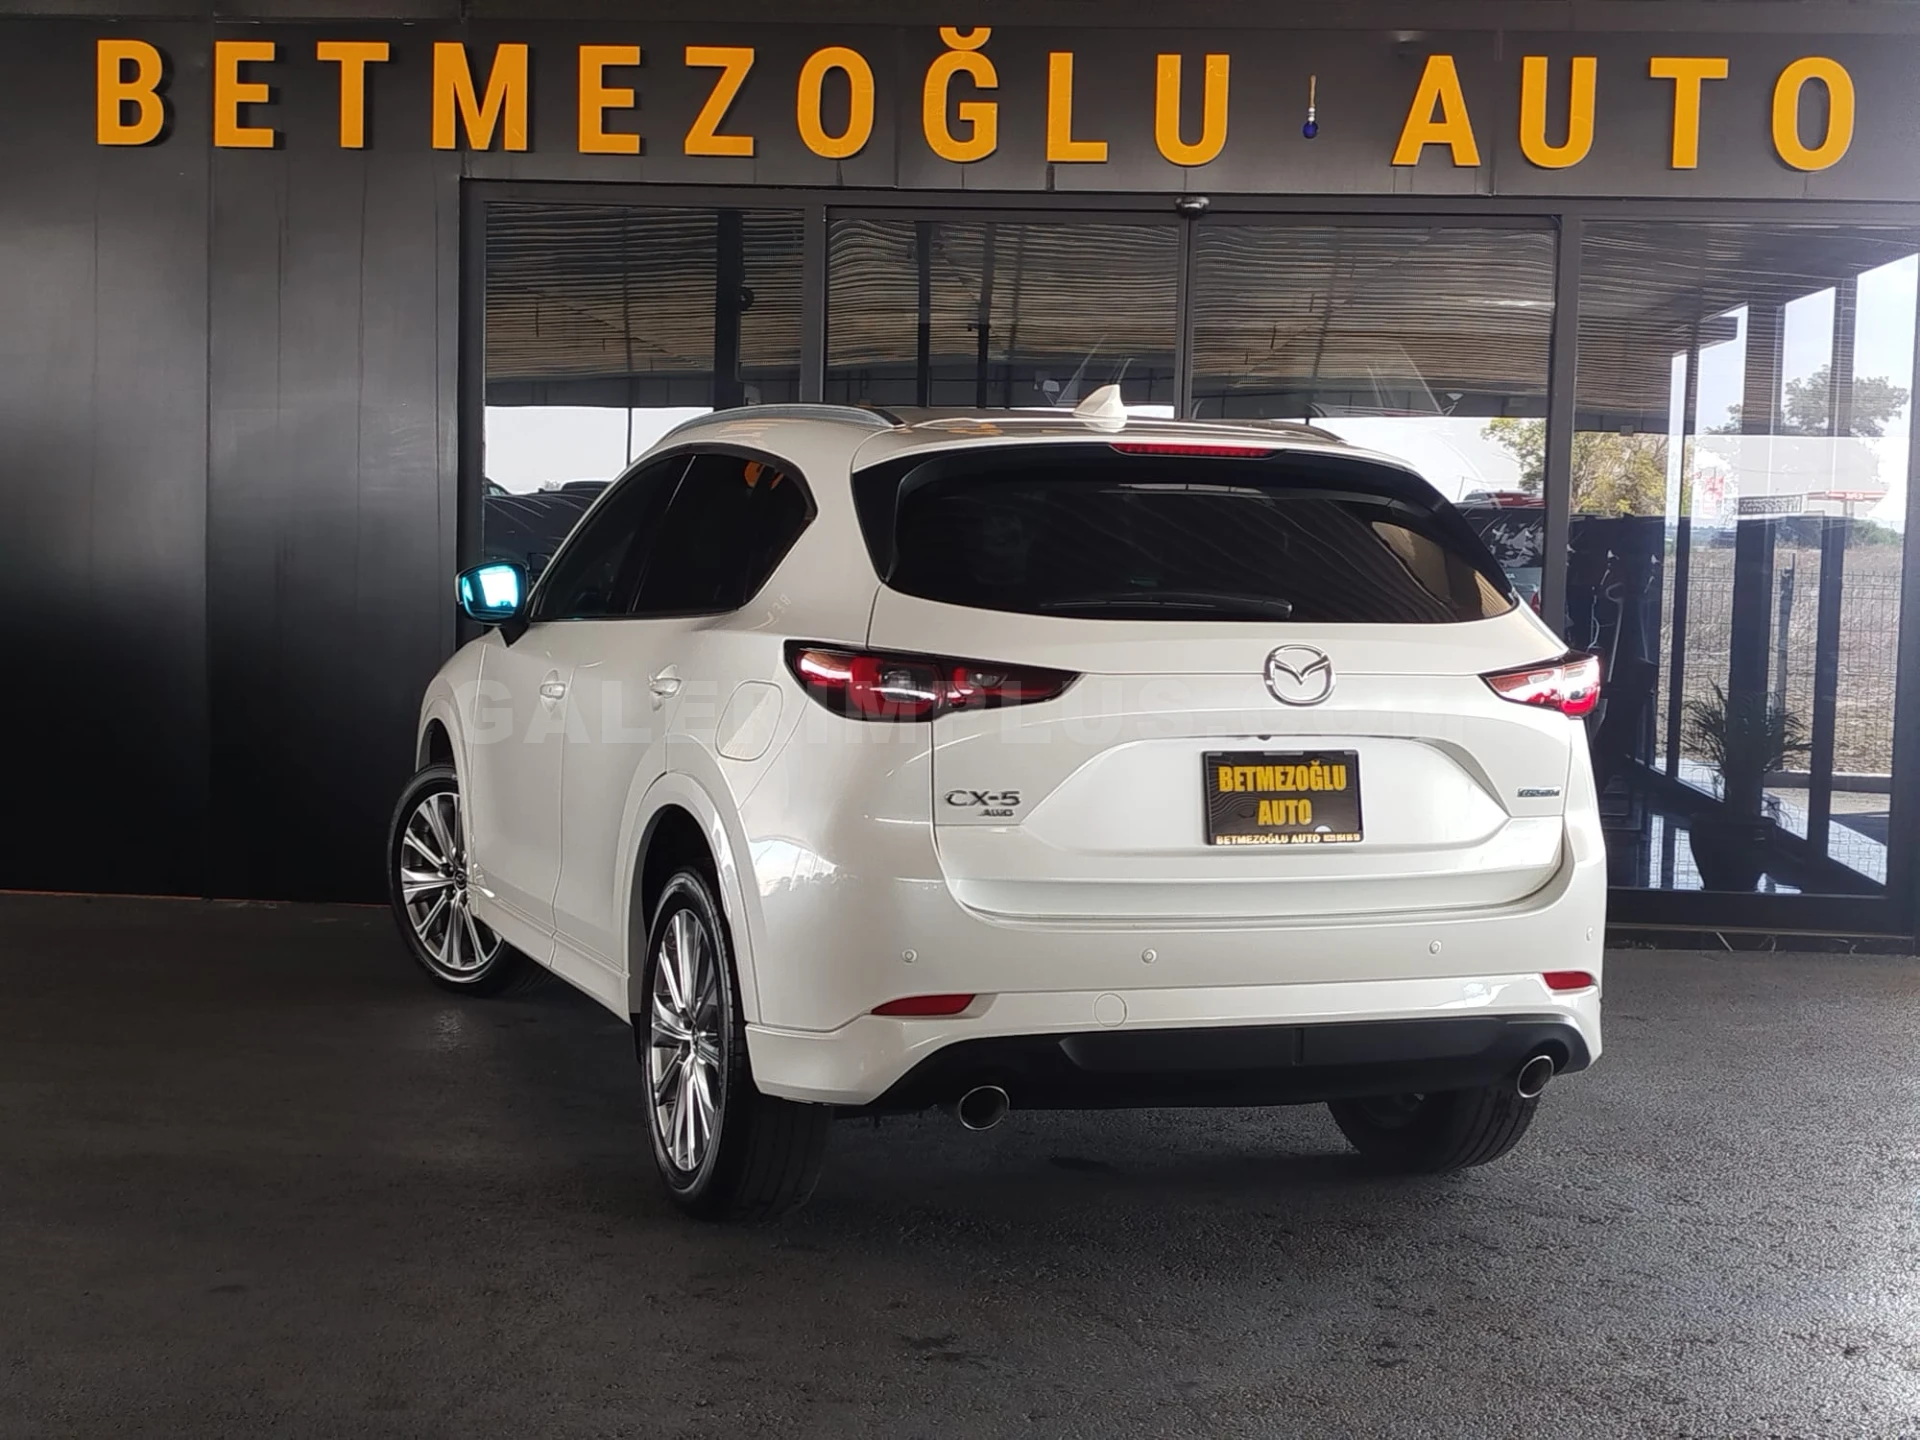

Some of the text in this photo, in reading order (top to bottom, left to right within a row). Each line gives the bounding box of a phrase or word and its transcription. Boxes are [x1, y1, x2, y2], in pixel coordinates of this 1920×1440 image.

[97, 27, 1853, 169] BETMEZOĞLU AUTO
[1217, 760, 1347, 792] BETMEZOĞLU
[945, 789, 1021, 807] CX-5
[978, 808, 1015, 817] AWD
[1257, 799, 1313, 826] AUTO
[1216, 833, 1289, 845] BETMEZOĞLU
[1291, 833, 1321, 844] AUTO
